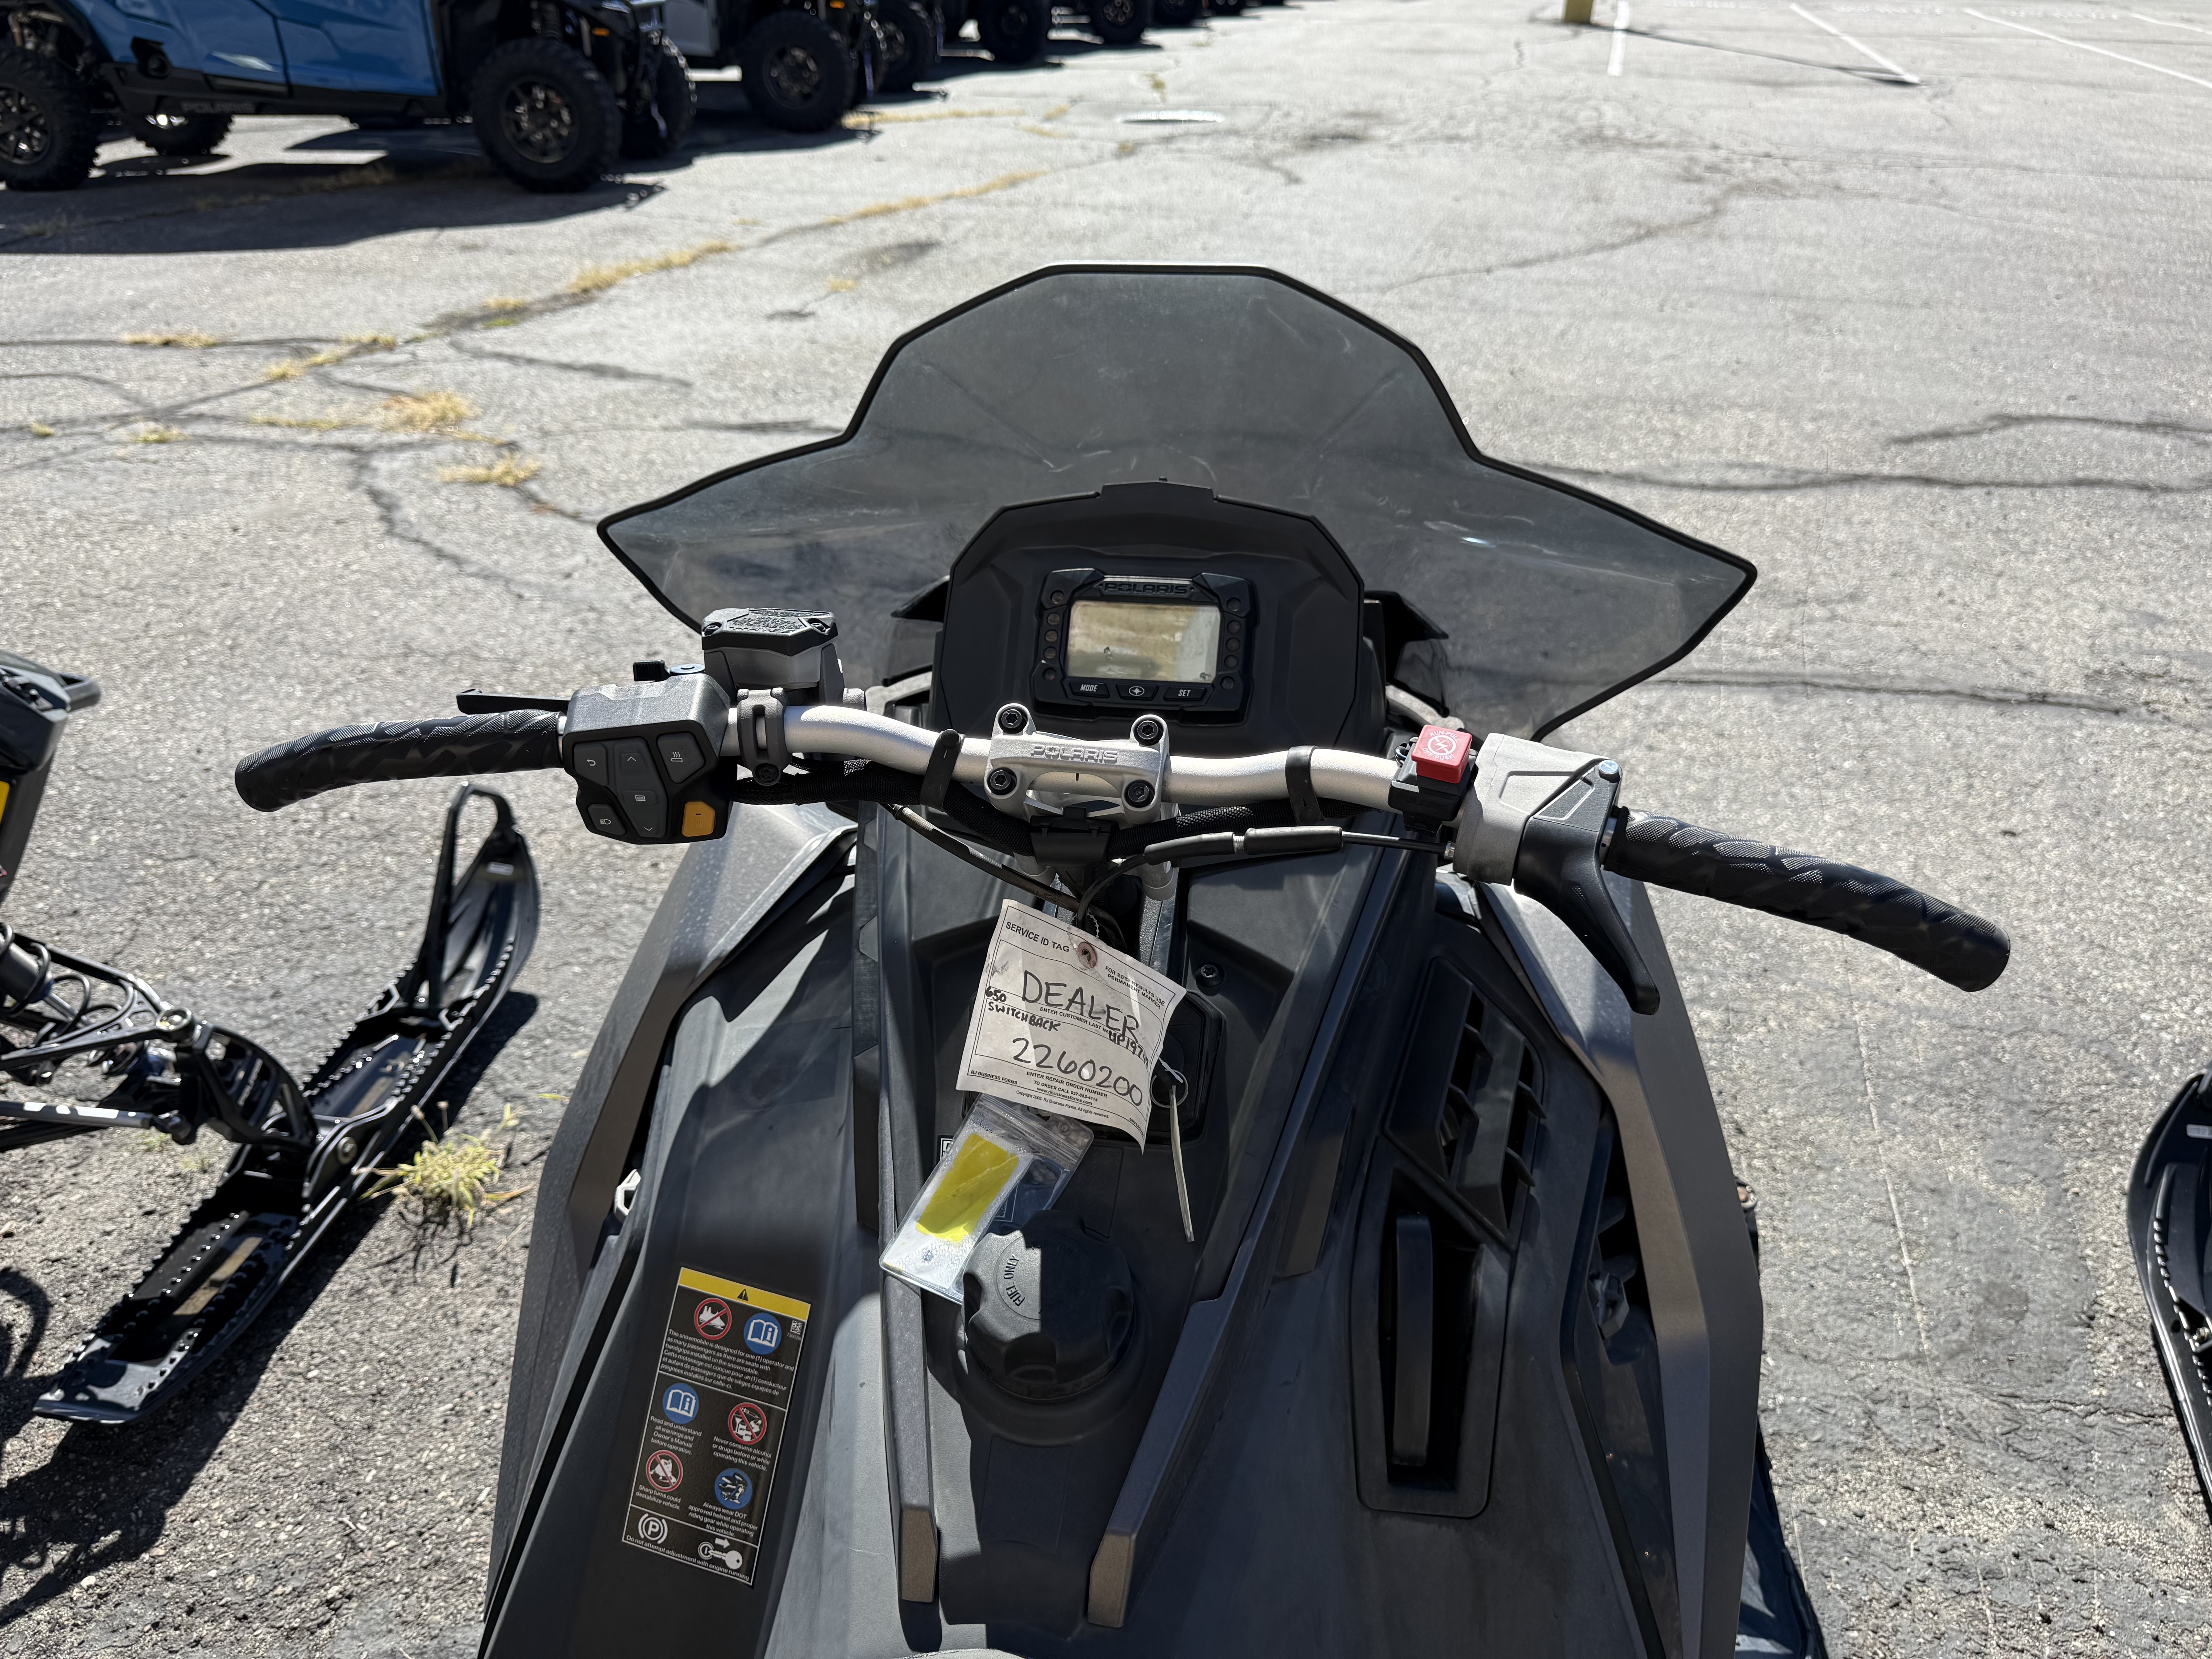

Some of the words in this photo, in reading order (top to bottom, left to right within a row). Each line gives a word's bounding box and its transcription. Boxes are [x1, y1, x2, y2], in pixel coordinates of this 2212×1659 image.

[1104, 583, 1187, 594] POLARIS
[1080, 684, 1098, 692] MODE
[1178, 689, 1191, 697] SET
[1030, 744, 1118, 764] POLARIS
[1006, 921, 1039, 942] SERVICE
[1041, 937, 1049, 946] ID
[1052, 941, 1069, 952] TAG
[986, 986, 1007, 1002] 650
[1106, 966, 1116, 975] FOR
[1117, 972, 1131, 982] BEST
[1132, 981, 1154, 998] RESULTS
[1156, 996, 1165, 1006] USE
[1108, 974, 1140, 993] PERMANENT
[1141, 992, 1161, 1010] MARKER
[1022, 970, 1139, 1042] DEALER
[988, 1001, 1061, 1032] SWITCHBACK
[1040, 1007, 1058, 1015] ENTER
[1059, 1012, 1088, 1024] CUSTOMER
[1089, 1021, 1101, 1030] LAST
[978, 1072, 1001, 1080] BUSINESS
[1012, 1037, 1143, 1106] 2260200
[1026, 1071, 1044, 1079] ENTER
[1046, 1076, 1064, 1085] REPAIR
[1066, 1082, 1084, 1091] ORDER
[1085, 1087, 1108, 1098] NUMBER
[1041, 1082, 1057, 1091] ORDER
[1016, 1090, 1033, 1099] Copyright
[1049, 1099, 1065, 1107] Business
[1037, 1087, 1092, 1106] www.rjbusinessforms.com
[1003, 1254, 1020, 1279] ONLY
[1006, 1281, 1025, 1307] FUEL
[665, 1343, 690, 1354] handgrips
[690, 1350, 711, 1360] installed
[673, 1339, 687, 1347] many
[687, 1343, 715, 1355] passengers
[679, 1333, 709, 1345] snowmobile
[714, 1343, 737, 1354] designed
[763, 1358, 784, 1367] operator
[664, 1349, 677, 1357] Cette
[677, 1354, 704, 1366] motoneige
[758, 1379, 787, 1390] conducteur
[668, 1358, 684, 1367] autant
[690, 1365, 716, 1377] passagers
[650, 1415, 663, 1424] Read
[673, 1424, 702, 1436] understand
[661, 1427, 684, 1438] warnings
[651, 1437, 667, 1446] before
[674, 1437, 692, 1447] Manual
[713, 1436, 728, 1444] Never
[729, 1442, 752, 1452] consume
[753, 1448, 771, 1458] alcohol
[713, 1451, 738, 1463] operating
[718, 1445, 733, 1453] drugs
[733, 1449, 750, 1458] before
[635, 1491, 662, 1503] destabilize
[639, 1484, 653, 1494] Sharp
[654, 1490, 666, 1498] turns
[703, 1502, 721, 1511] Always
[688, 1505, 713, 1516] approved
[713, 1512, 730, 1521] helmet
[740, 1521, 757, 1530] proper
[689, 1512, 703, 1521] riding
[729, 1525, 754, 1537] operating
[647, 1521, 660, 1536] P
[644, 1542, 665, 1553] attempt
[665, 1549, 696, 1563] adjustment
[709, 1564, 728, 1573] engine
[728, 1570, 749, 1581] running
